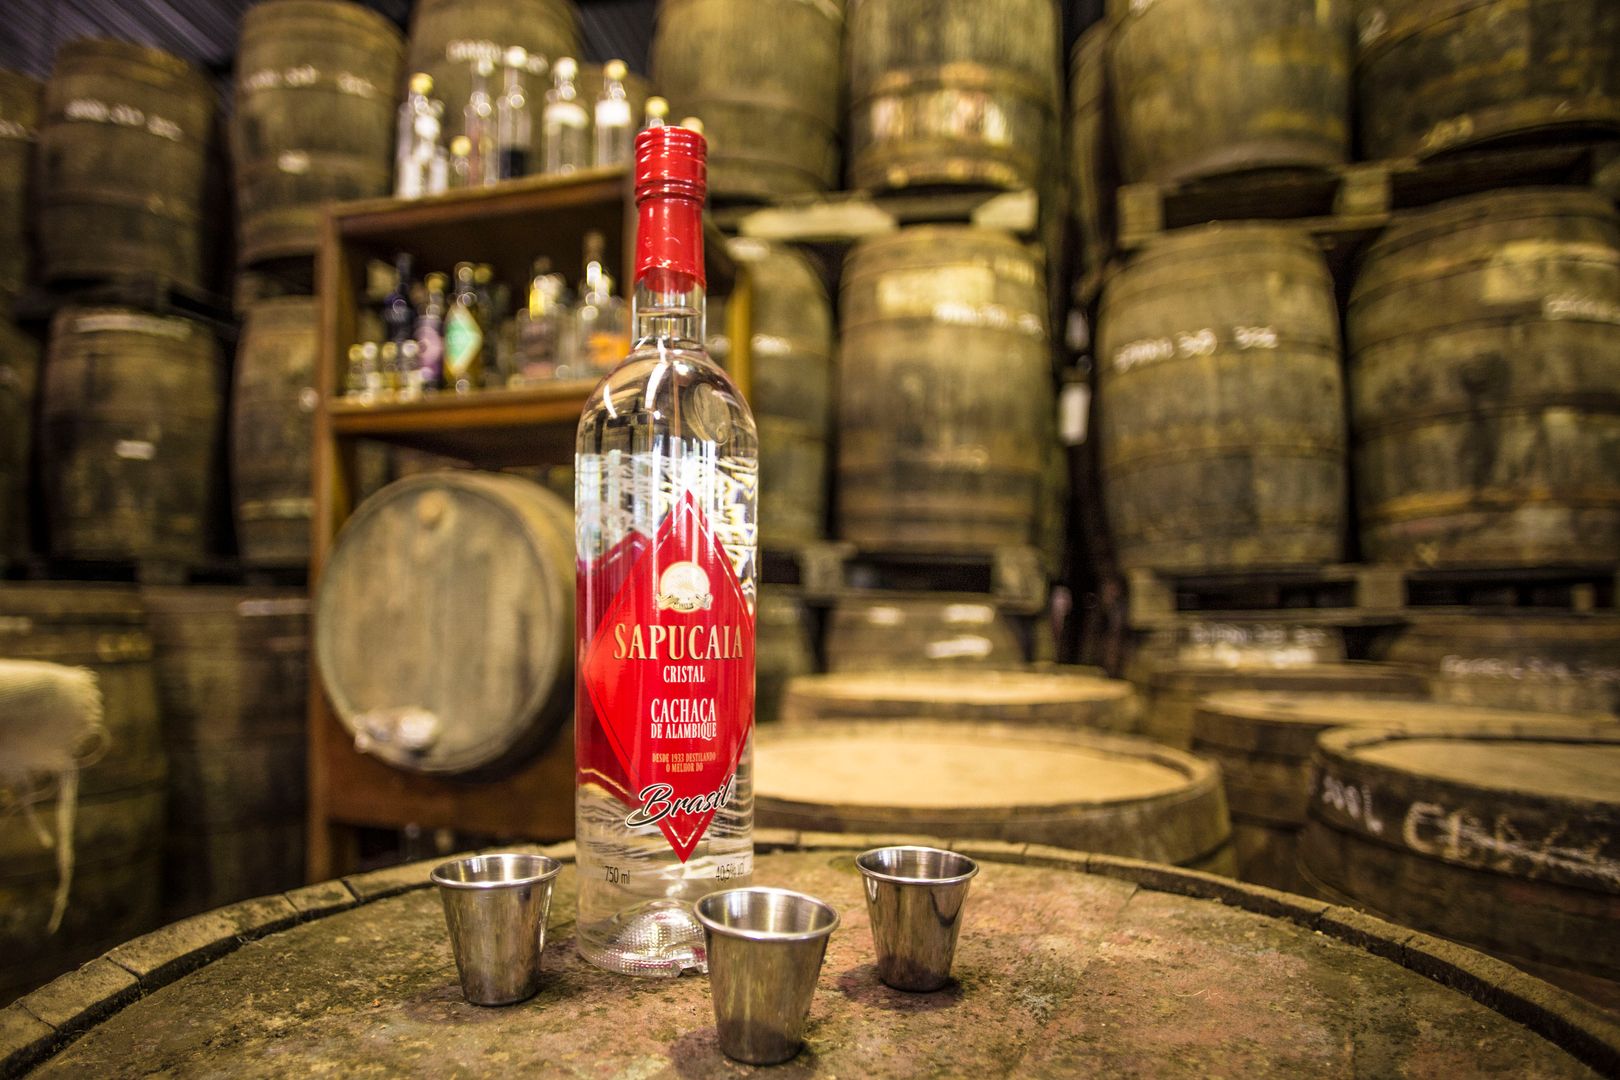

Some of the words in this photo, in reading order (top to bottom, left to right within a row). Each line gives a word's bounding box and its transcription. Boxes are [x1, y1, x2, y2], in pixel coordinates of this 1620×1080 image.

[612, 623, 744, 660] SAPUCAIA
[663, 665, 706, 683] CRISTAL
[651, 697, 717, 723] CACHAÇA
[651, 723, 663, 739] DE
[665, 722, 717, 741] ALAMBIQUE
[652, 752, 670, 763] DESDE
[671, 752, 685, 763] 1933
[665, 763, 671, 773] O
[671, 763, 695, 773] MELHOR
[695, 762, 704, 772] DO
[625, 773, 737, 828] Brasil
[604, 865, 619, 884] 750
[620, 869, 631, 885] ml
